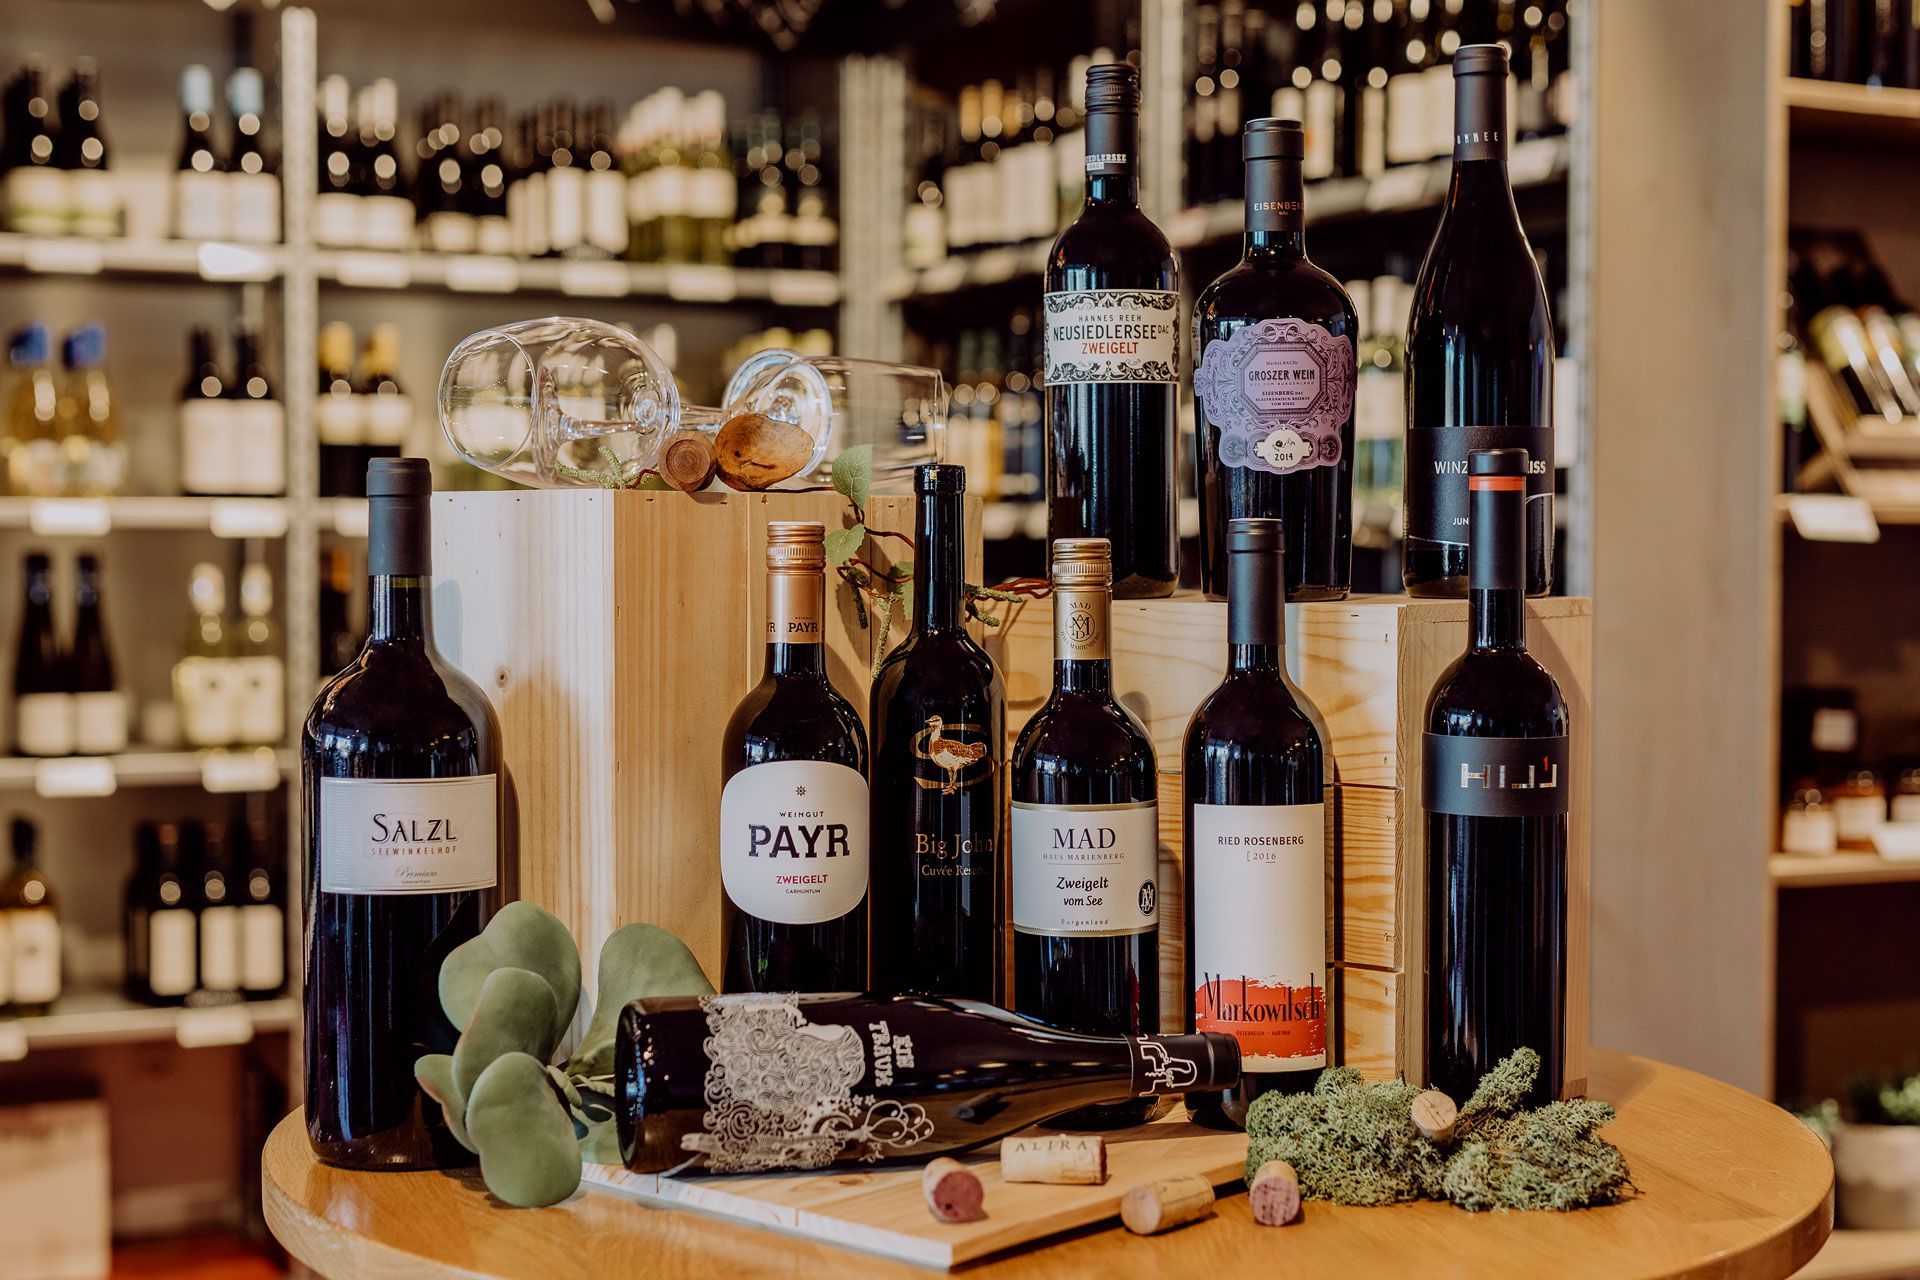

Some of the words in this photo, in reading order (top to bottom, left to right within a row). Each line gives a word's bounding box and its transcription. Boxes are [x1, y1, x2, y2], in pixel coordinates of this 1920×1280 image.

[1078, 314, 1114, 322] HANNES
[1119, 314, 1142, 322] REEH
[1053, 324, 1157, 341] NEUSIEDLERSEE
[1081, 342, 1139, 354] ZWEIGELT
[1248, 370, 1290, 381] GROSZER
[1293, 369, 1315, 380] WEIN
[1274, 452, 1293, 461] 2014
[1434, 460, 1468, 475] WINZ
[1452, 517, 1469, 526] JUN
[788, 622, 819, 633] PAYR
[748, 823, 850, 859] PAYR
[1052, 827, 1116, 849] MAD
[1218, 836, 1241, 846] RIED
[1244, 835, 1304, 846] ROSENBERG
[371, 845, 457, 856] SEEWINKELHOF
[915, 833, 948, 860] Big
[1067, 853, 1125, 861] MARIENBERG
[921, 864, 953, 877] Cuvée
[776, 875, 828, 884] ZWEIGELT
[1056, 876, 1109, 891] Zweigelt
[1063, 897, 1085, 906] vom
[1086, 895, 1103, 906] See
[893, 1035, 914, 1068] EIN
[1016, 1140, 1087, 1152] ALIRA
